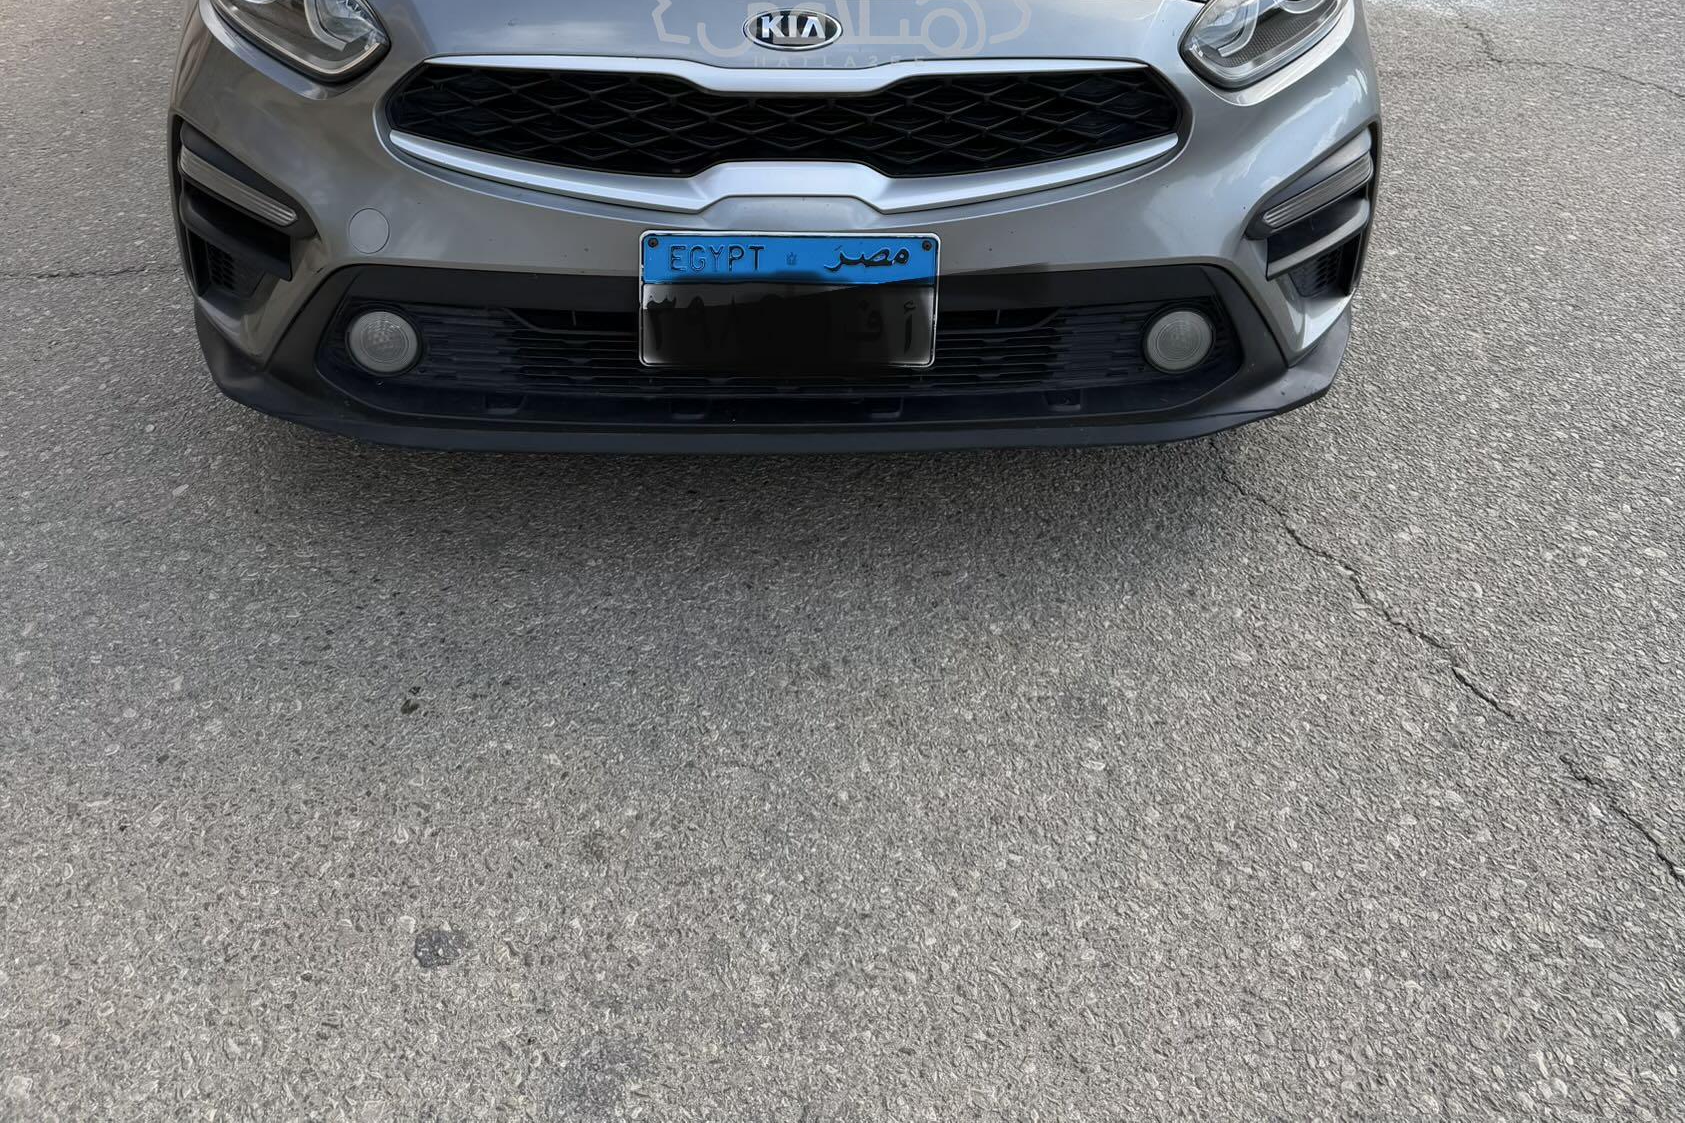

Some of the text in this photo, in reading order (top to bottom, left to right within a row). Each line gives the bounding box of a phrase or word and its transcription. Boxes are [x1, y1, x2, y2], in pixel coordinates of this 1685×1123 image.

[761, 15, 826, 38] KIA
[670, 245, 765, 272] EGYPT
[824, 244, 911, 272] مصر
